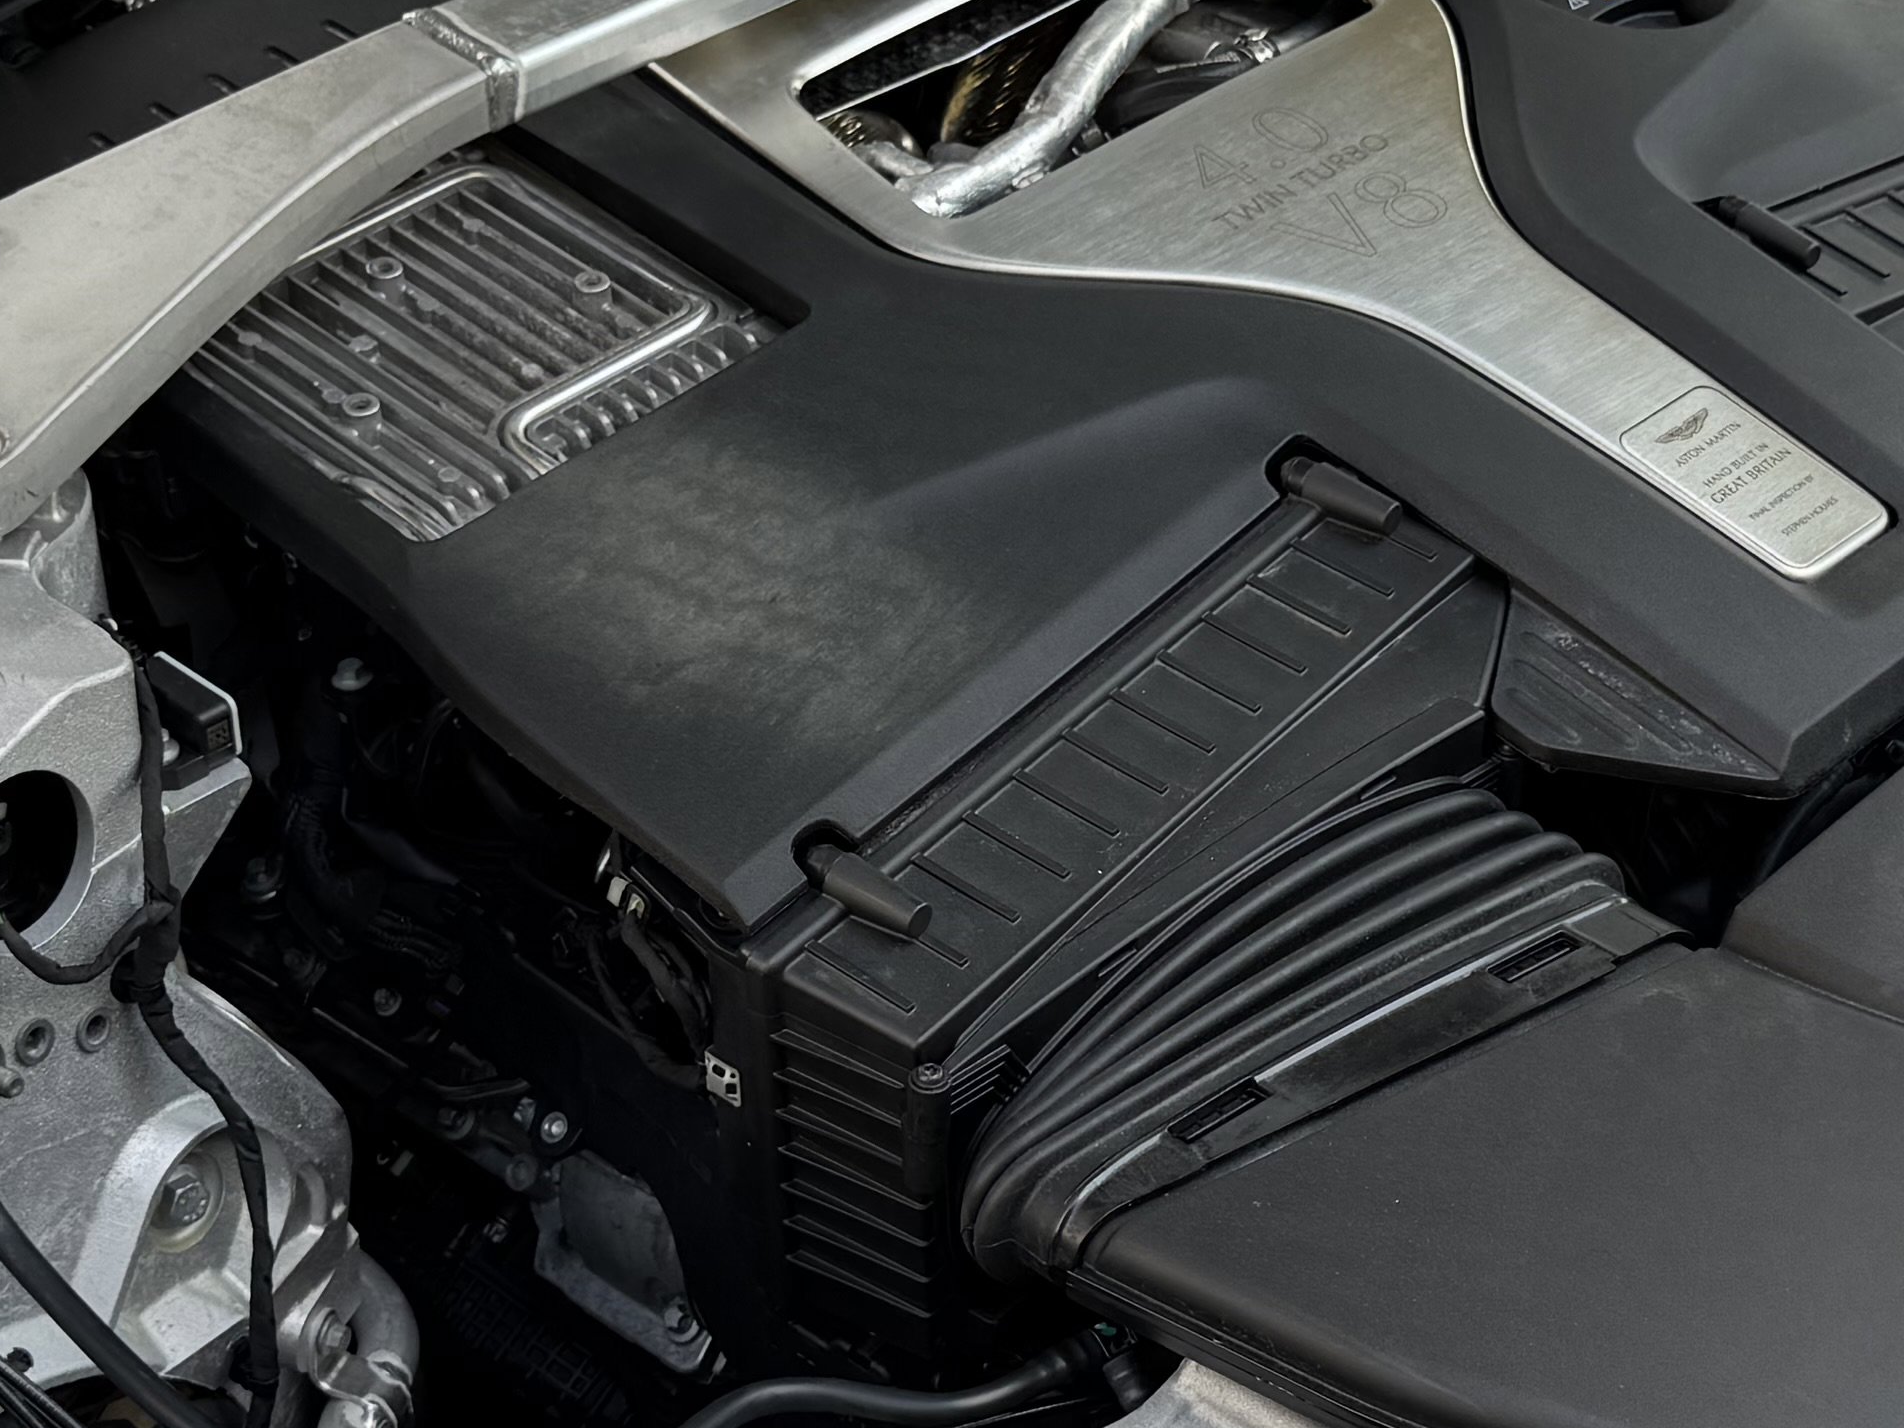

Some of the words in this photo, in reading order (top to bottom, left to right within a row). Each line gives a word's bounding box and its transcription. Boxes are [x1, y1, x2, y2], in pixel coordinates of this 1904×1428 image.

[1211, 183, 1298, 230] TWIN
[1289, 134, 1388, 188] TURBO
[1269, 172, 1447, 257] V8
[1675, 443, 1705, 467] ASTON
[1705, 422, 1741, 448] MARTIN
[1702, 466, 1732, 488] HAND
[1733, 449, 1756, 470] BUILT
[1757, 442, 1769, 453] IN
[1710, 476, 1749, 504] GREAT
[1746, 447, 1792, 481] BRITAIN
